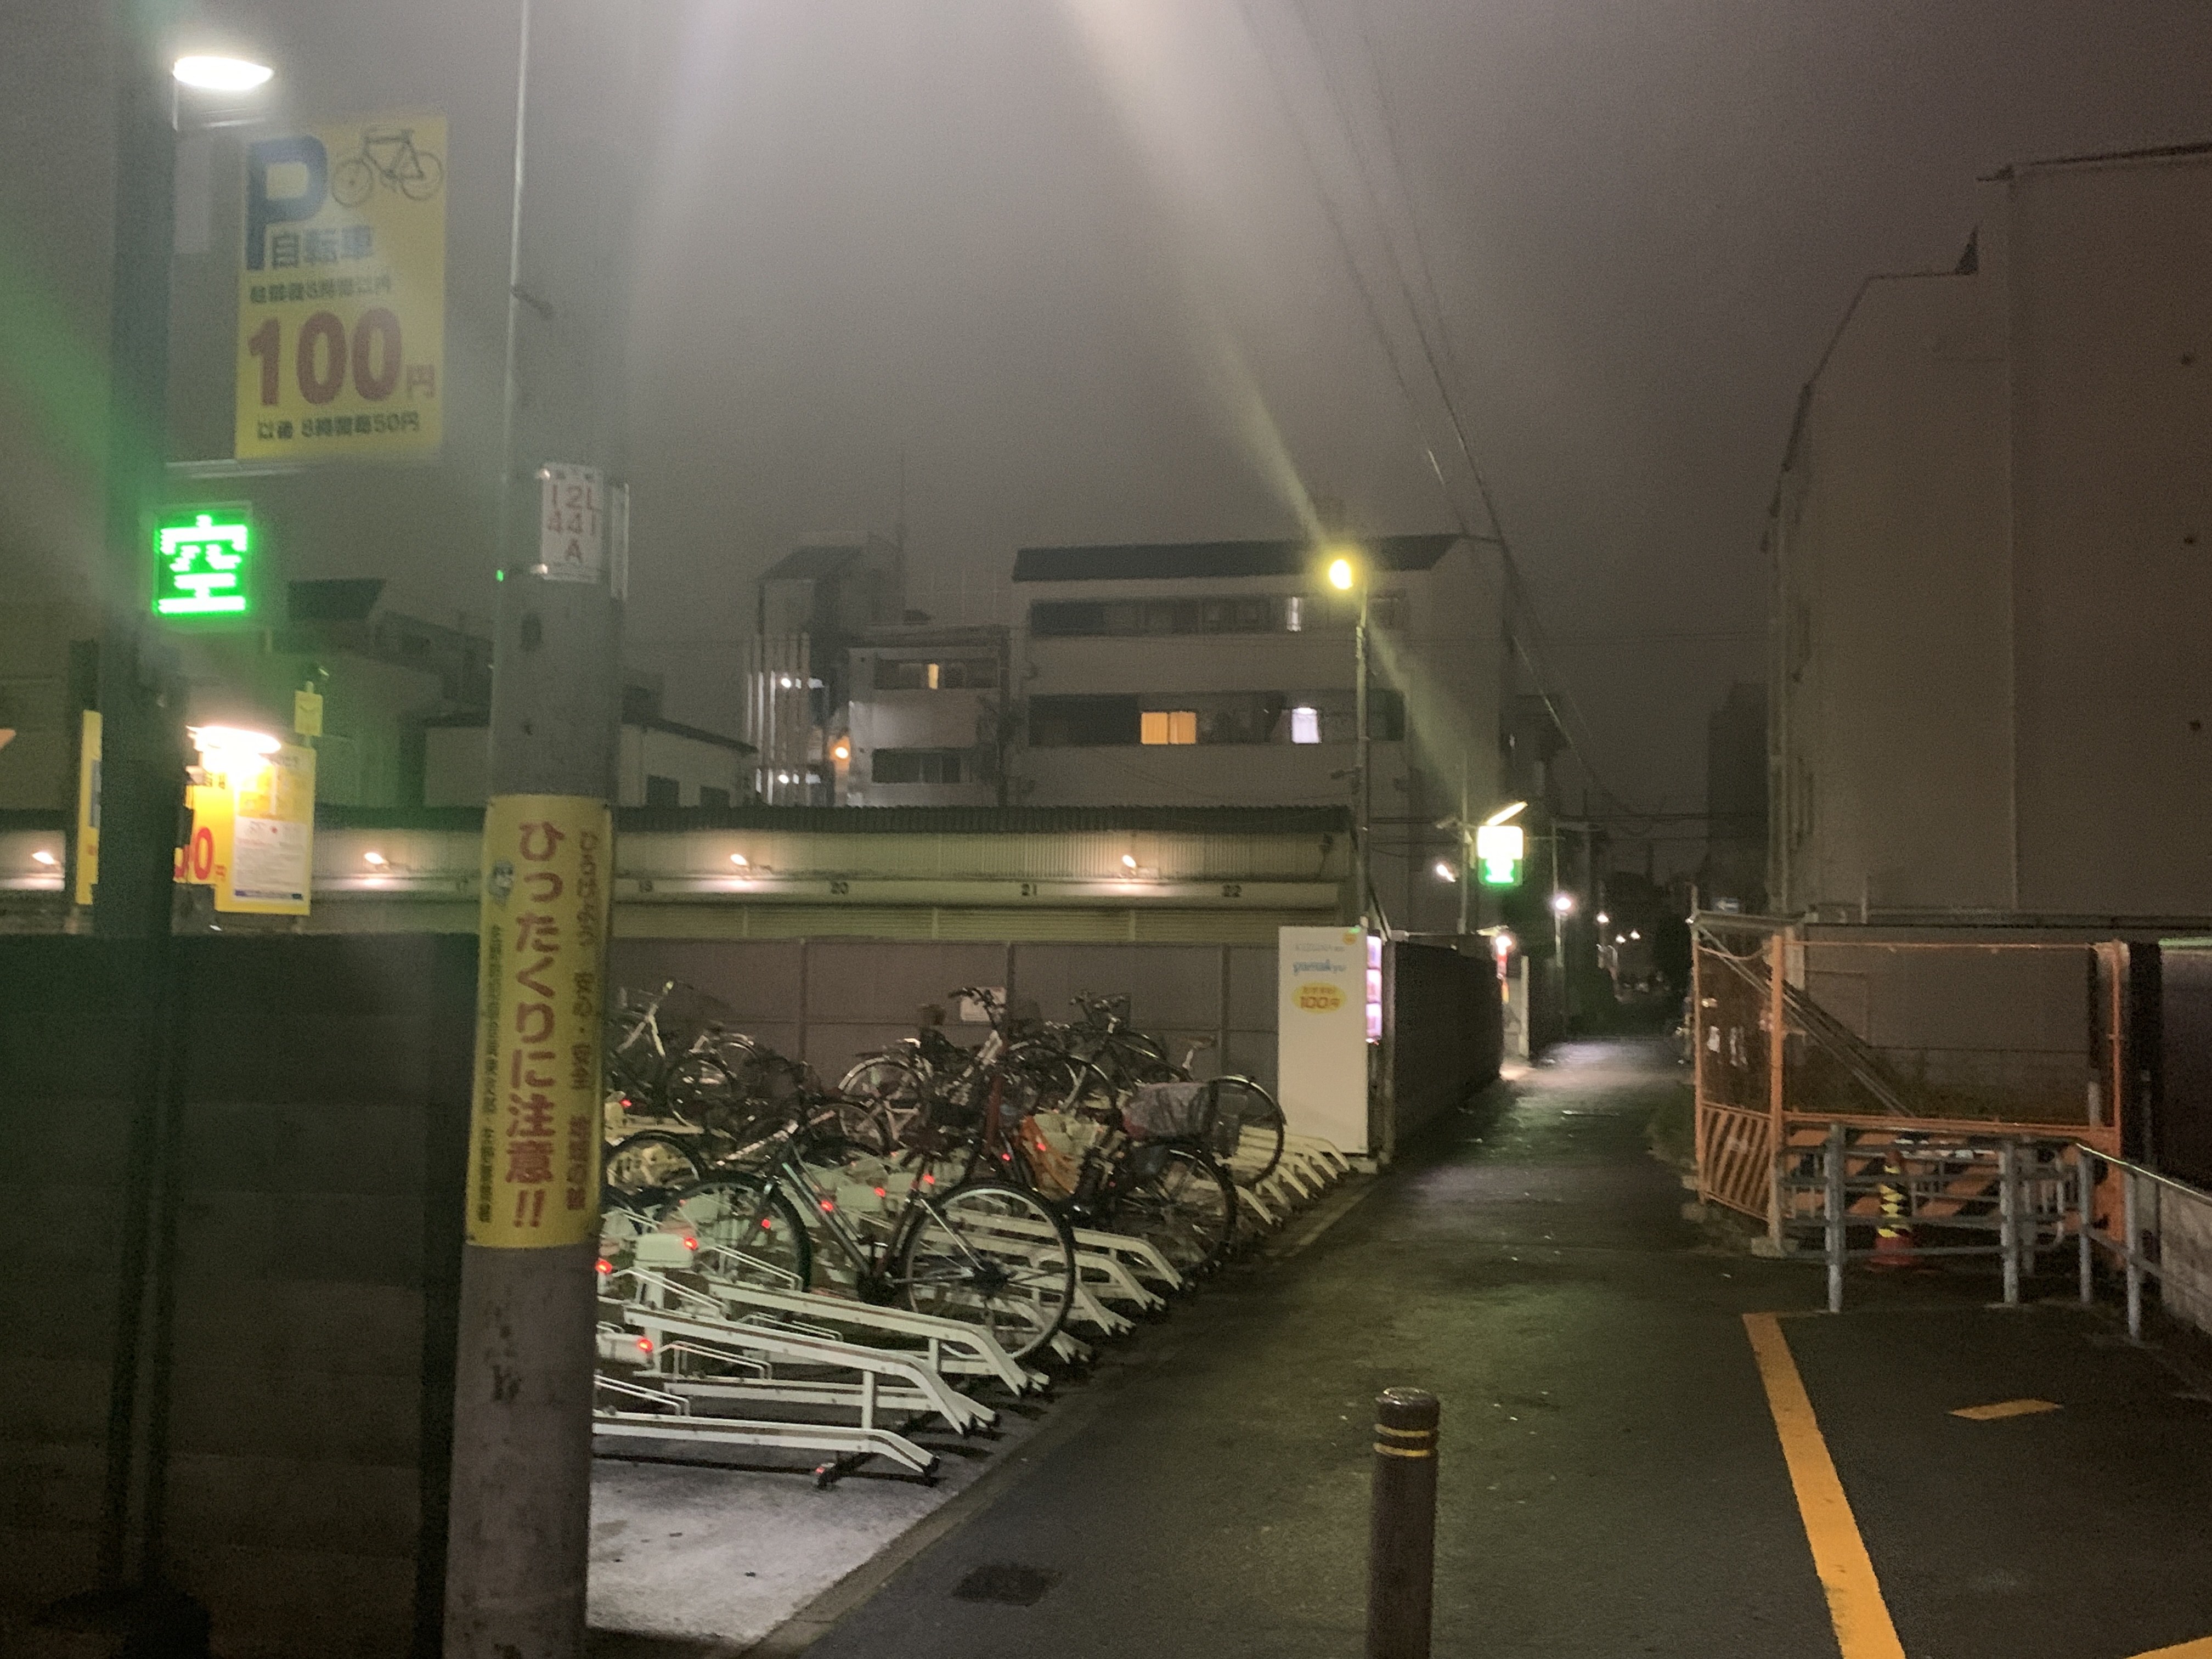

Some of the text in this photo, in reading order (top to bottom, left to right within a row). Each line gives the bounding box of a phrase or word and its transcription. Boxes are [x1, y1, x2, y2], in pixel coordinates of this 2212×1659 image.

[246, 135, 328, 270] P
[158, 515, 247, 614] 空
[831, 881, 849, 894] 20
[1021, 883, 1037, 896] 21
[1221, 884, 1242, 898] 22
